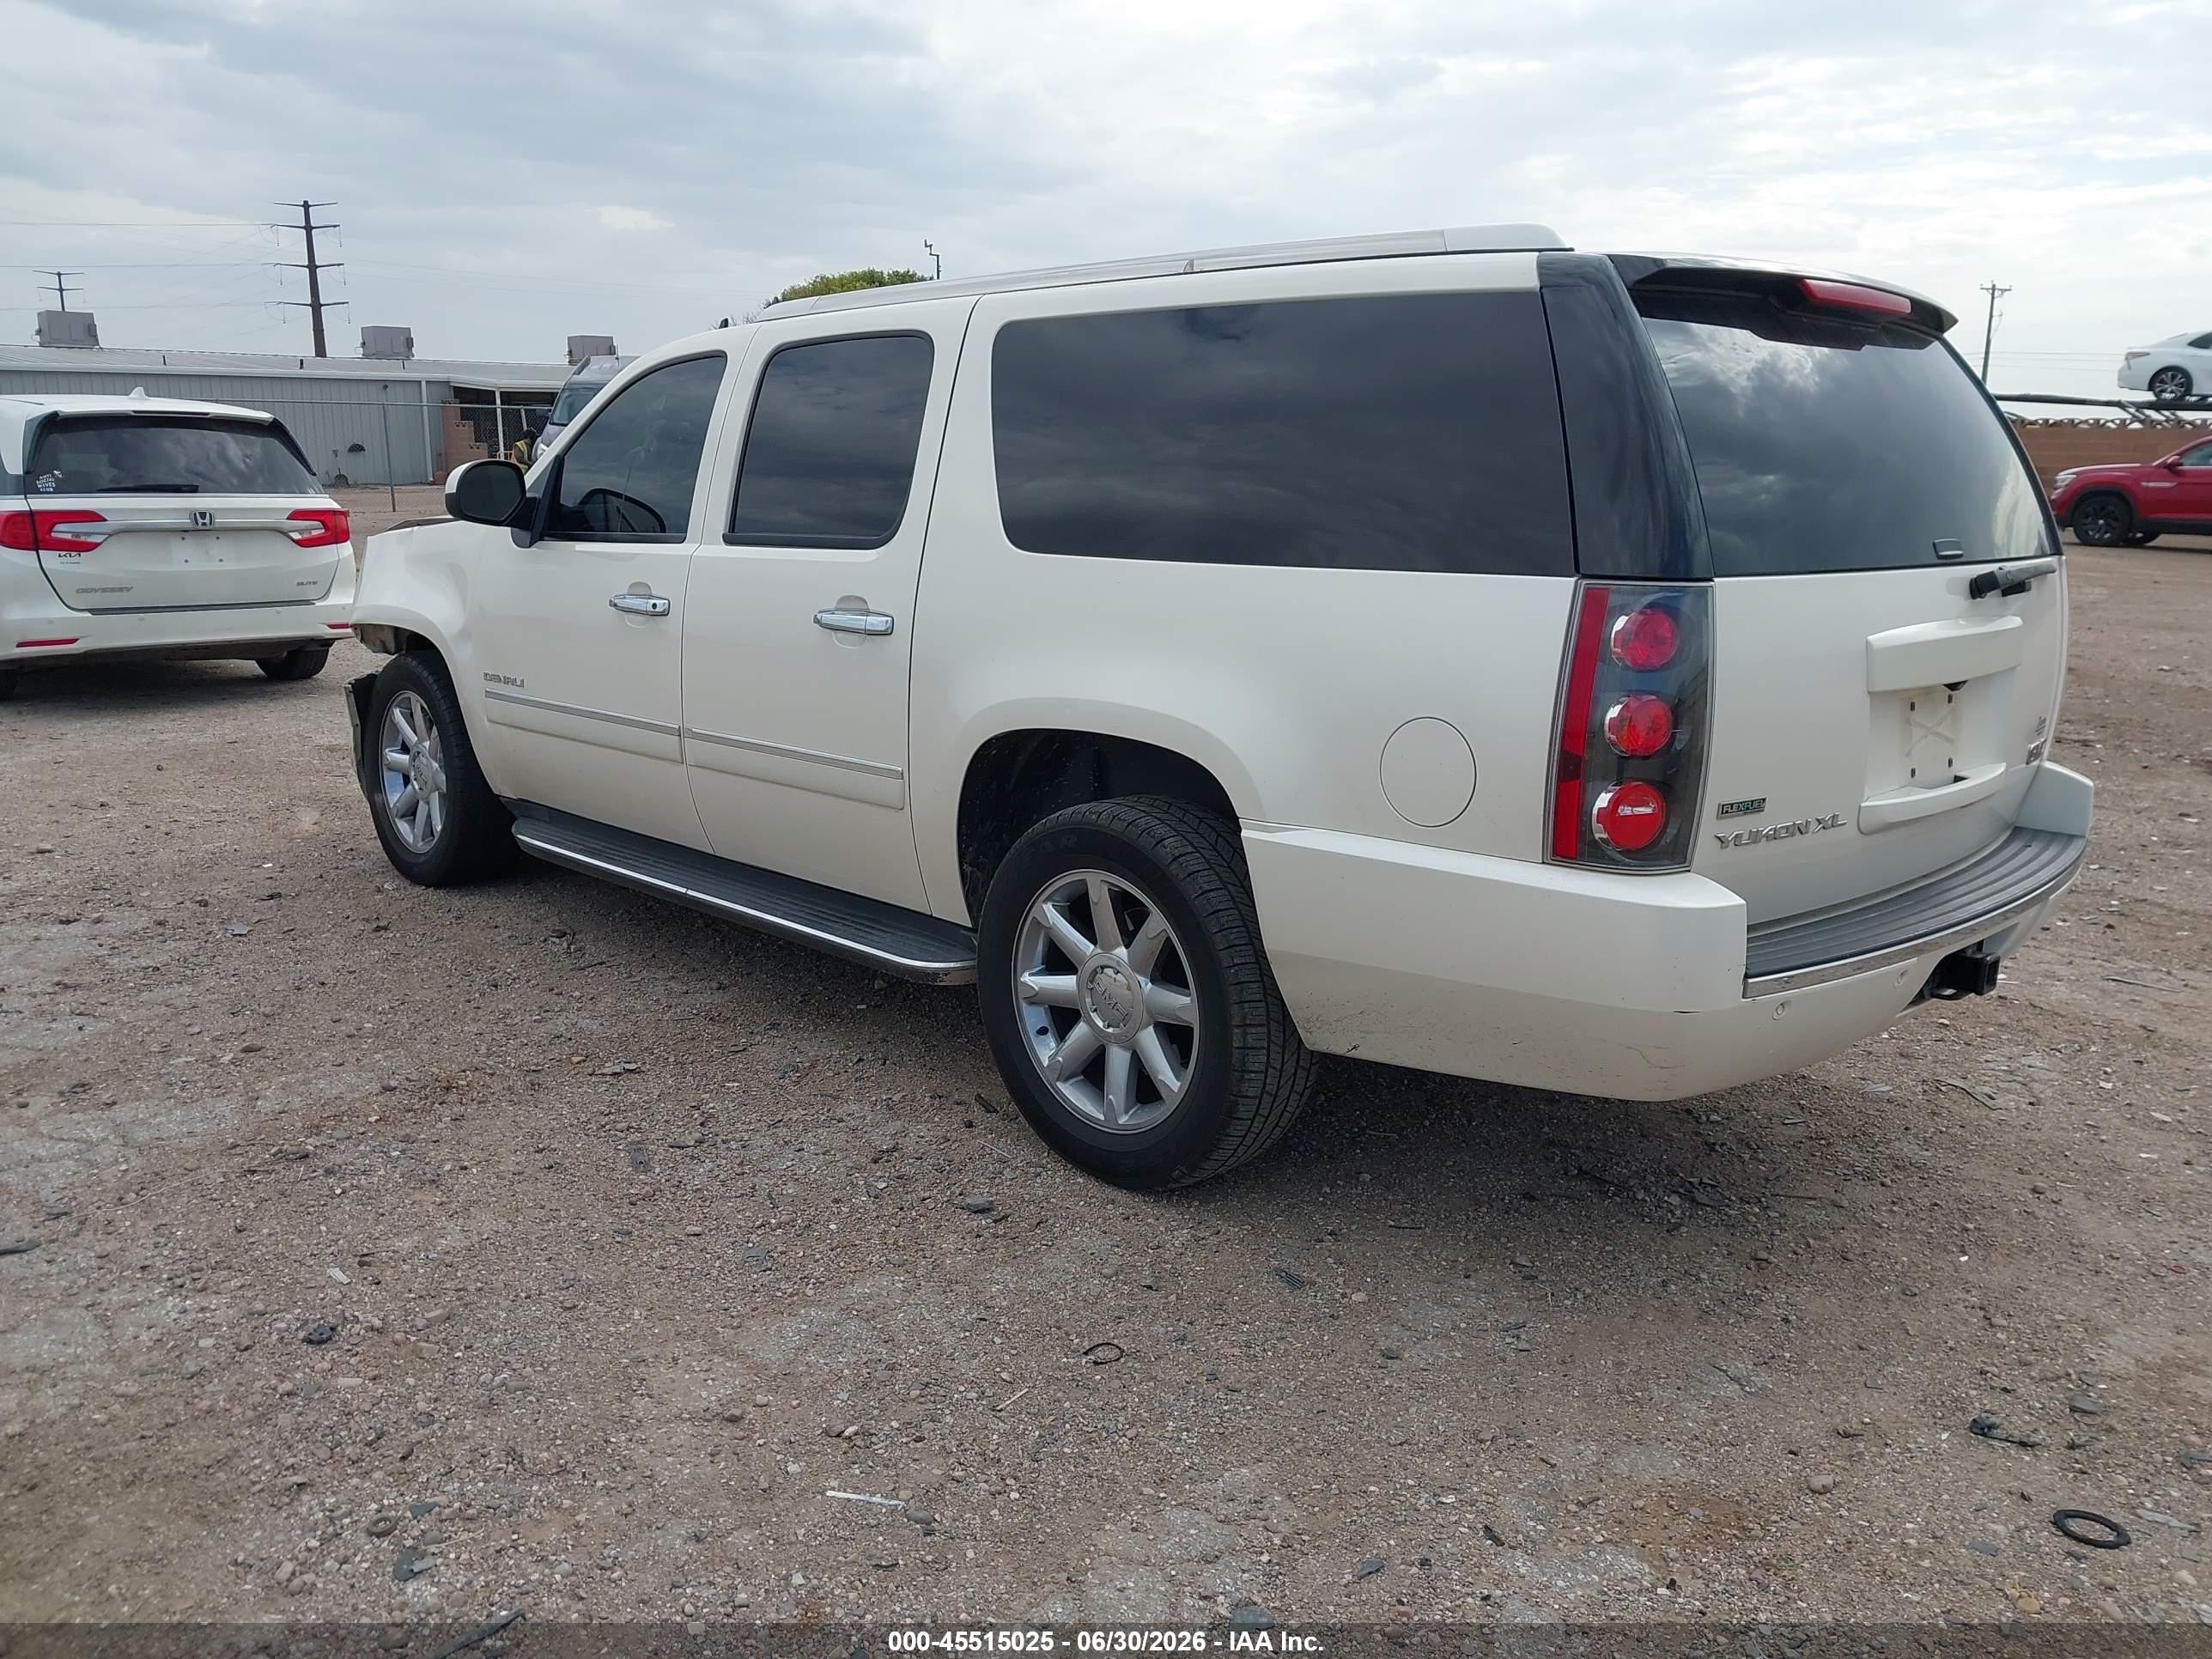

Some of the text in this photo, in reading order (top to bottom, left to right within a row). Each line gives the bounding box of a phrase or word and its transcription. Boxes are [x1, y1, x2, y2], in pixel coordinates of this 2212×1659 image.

[483, 672, 525, 688] DENALI
[1715, 811, 1848, 849] YUKON XL
[1092, 977, 1127, 1021] GMC
